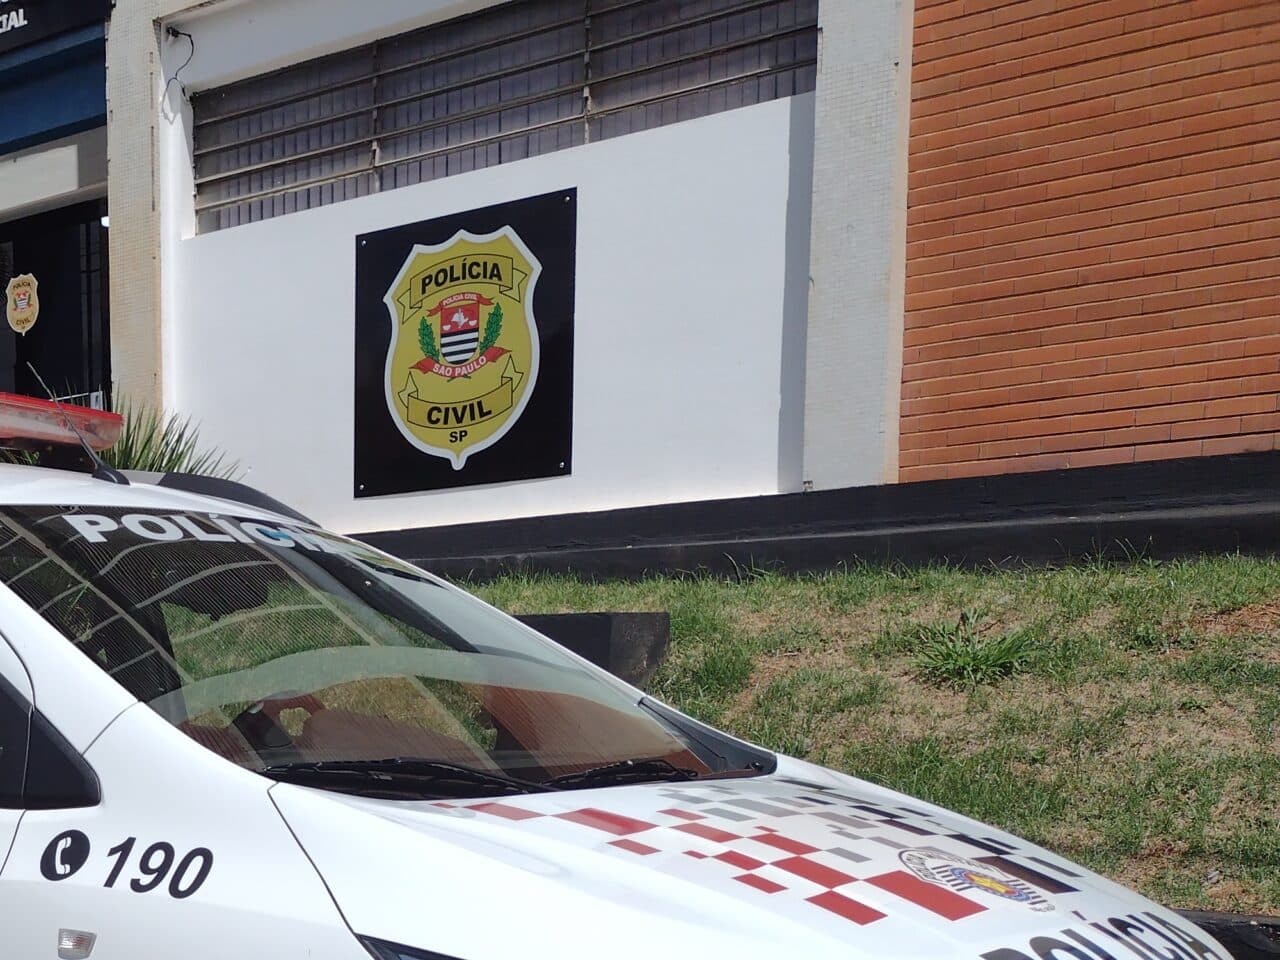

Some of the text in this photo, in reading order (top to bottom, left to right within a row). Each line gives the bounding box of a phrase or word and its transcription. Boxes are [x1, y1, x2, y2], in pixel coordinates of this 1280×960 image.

[421, 257, 503, 295] POLÍCIA
[455, 356, 487, 377] PAULO
[427, 400, 492, 426] CIVIL
[449, 430, 468, 444] SP
[103, 836, 214, 899] 190
